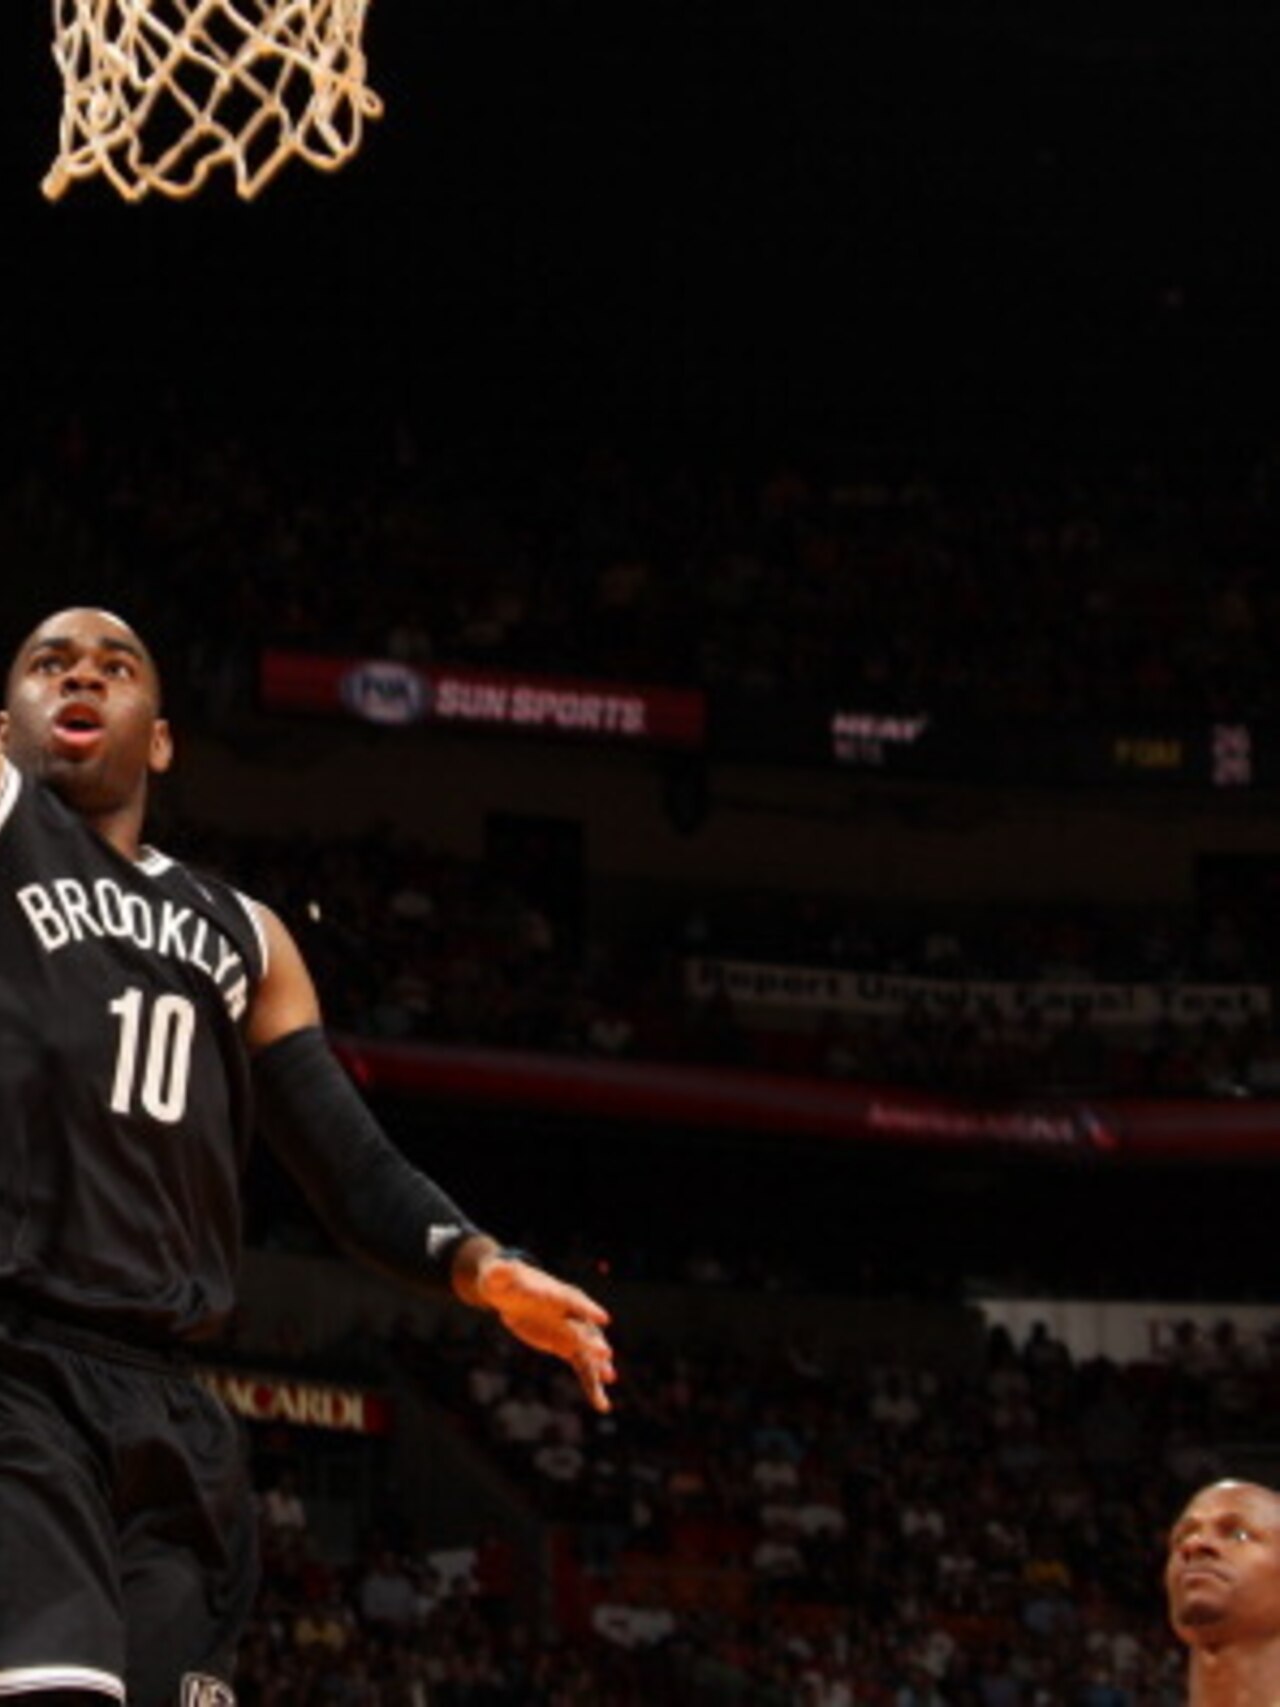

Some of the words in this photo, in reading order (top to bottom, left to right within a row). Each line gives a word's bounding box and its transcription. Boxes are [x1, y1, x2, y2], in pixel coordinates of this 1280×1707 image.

[433, 678, 508, 724] SUN
[511, 685, 647, 738] SPORTS
[830, 708, 929, 743] HEAT
[108, 986, 195, 1124] 10
